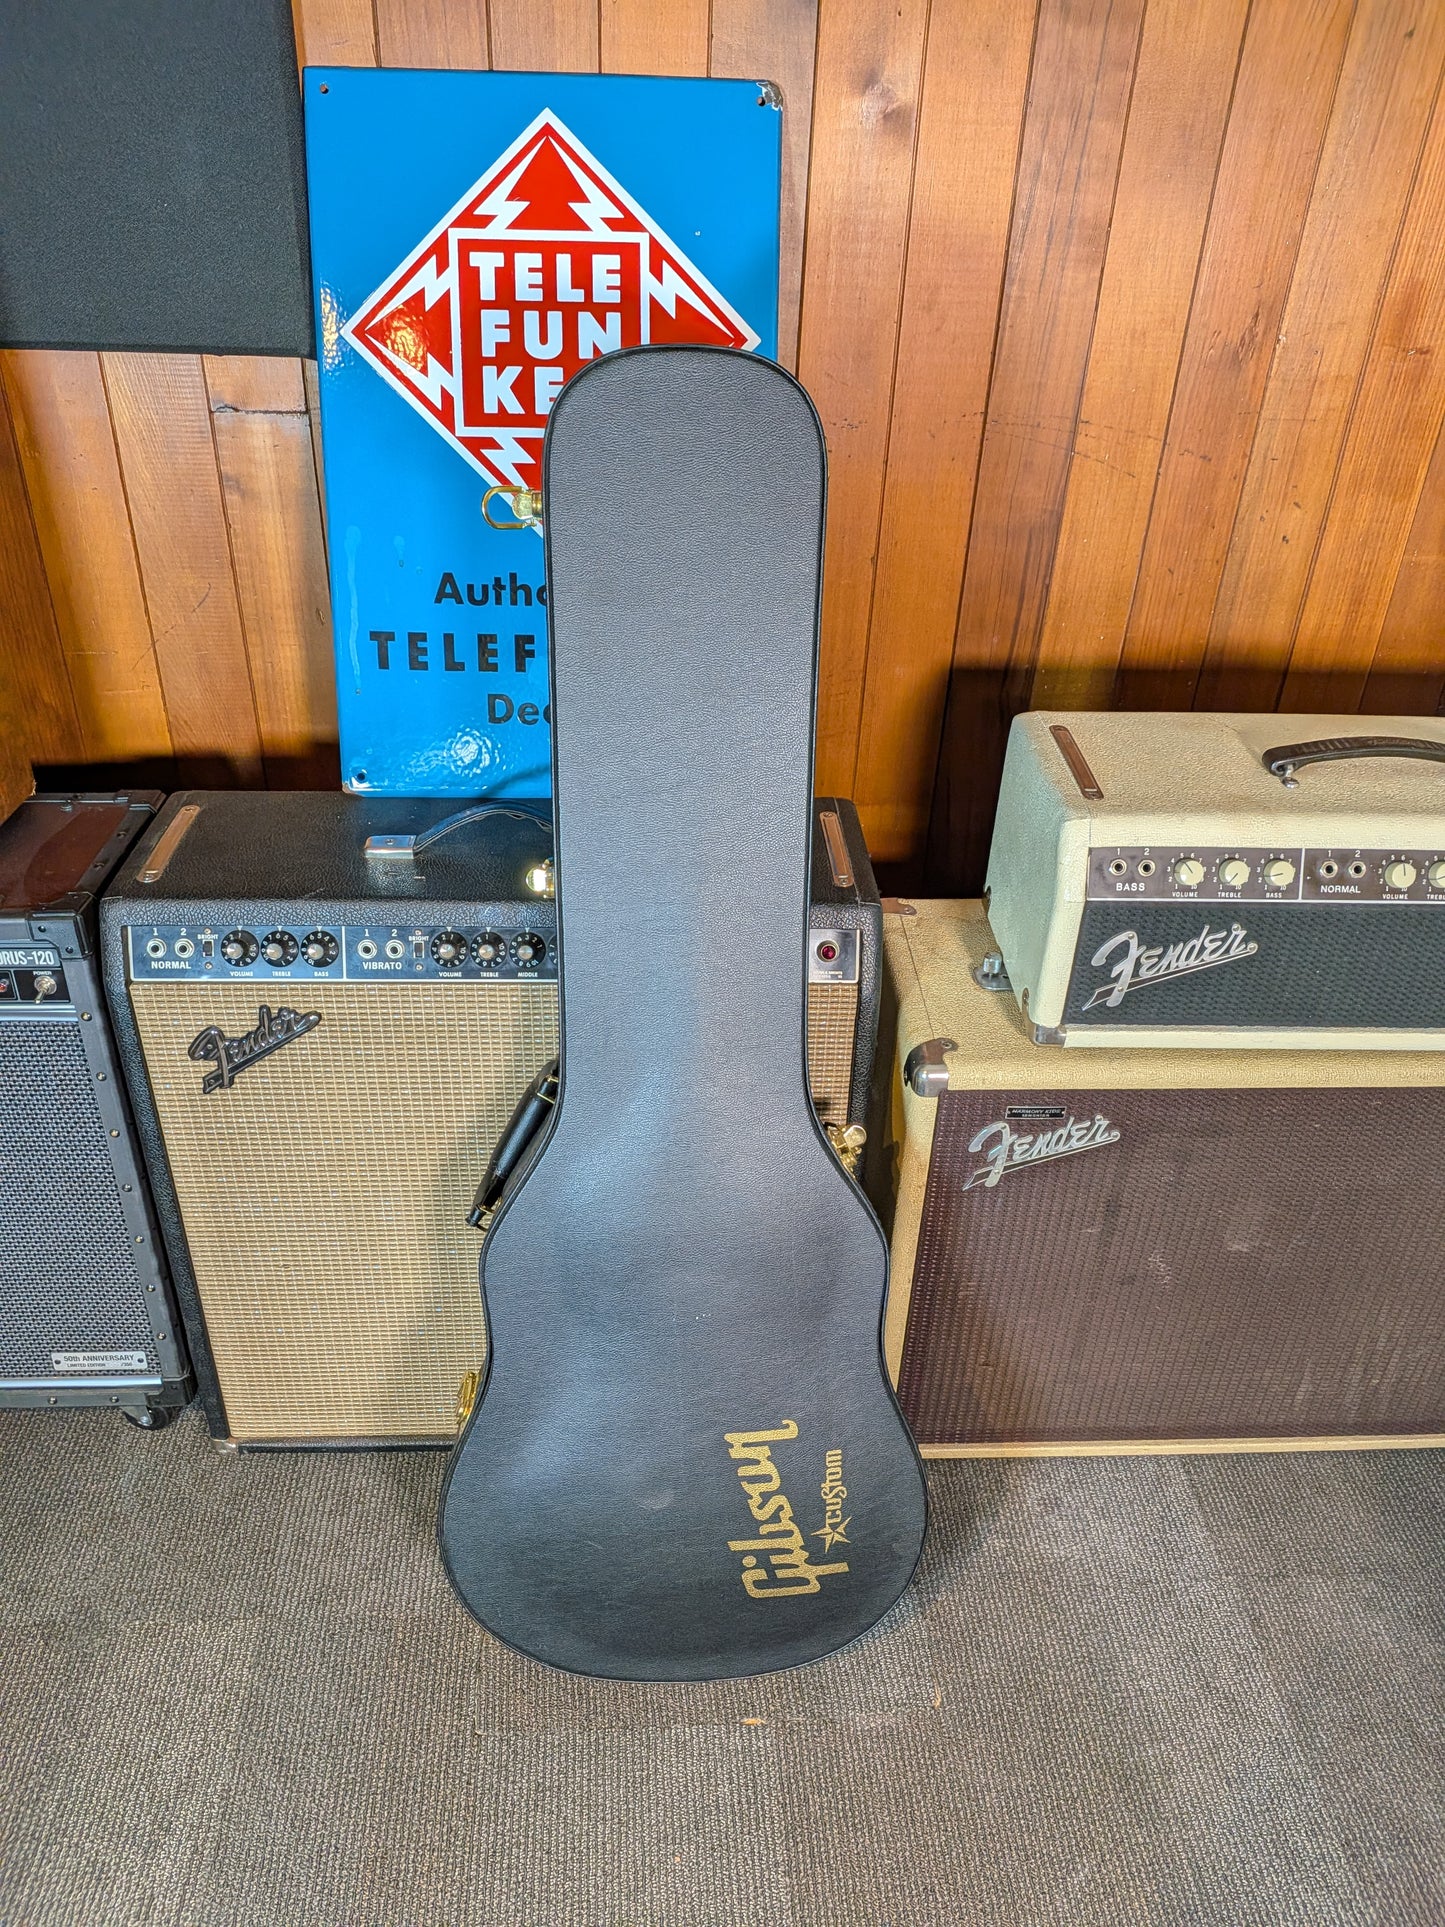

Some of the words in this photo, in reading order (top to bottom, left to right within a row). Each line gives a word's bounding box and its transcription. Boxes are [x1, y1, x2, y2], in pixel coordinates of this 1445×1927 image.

[469, 251, 621, 303] TELE
[480, 309, 622, 360] FUN
[482, 365, 564, 415] KE
[369, 630, 536, 673] TELEF
[1117, 847, 1121, 856] 1
[1143, 847, 1150, 856] 2
[1354, 850, 1361, 858] 2
[1116, 882, 1145, 891] BASS
[1320, 885, 1361, 893] NORMAL
[152, 927, 159, 936] 1
[180, 927, 187, 936] 2
[364, 928, 370, 937] 1
[391, 928, 398, 937] 2
[151, 961, 192, 969] NORMAL
[362, 961, 402, 970] VIBRATO
[1083, 923, 1258, 1010] Fender
[188, 1004, 322, 1094] Fender
[963, 1114, 1121, 1190] Fender
[82, 1354, 134, 1362] ANNIVERSARY
[724, 1419, 850, 1599] Gibson
